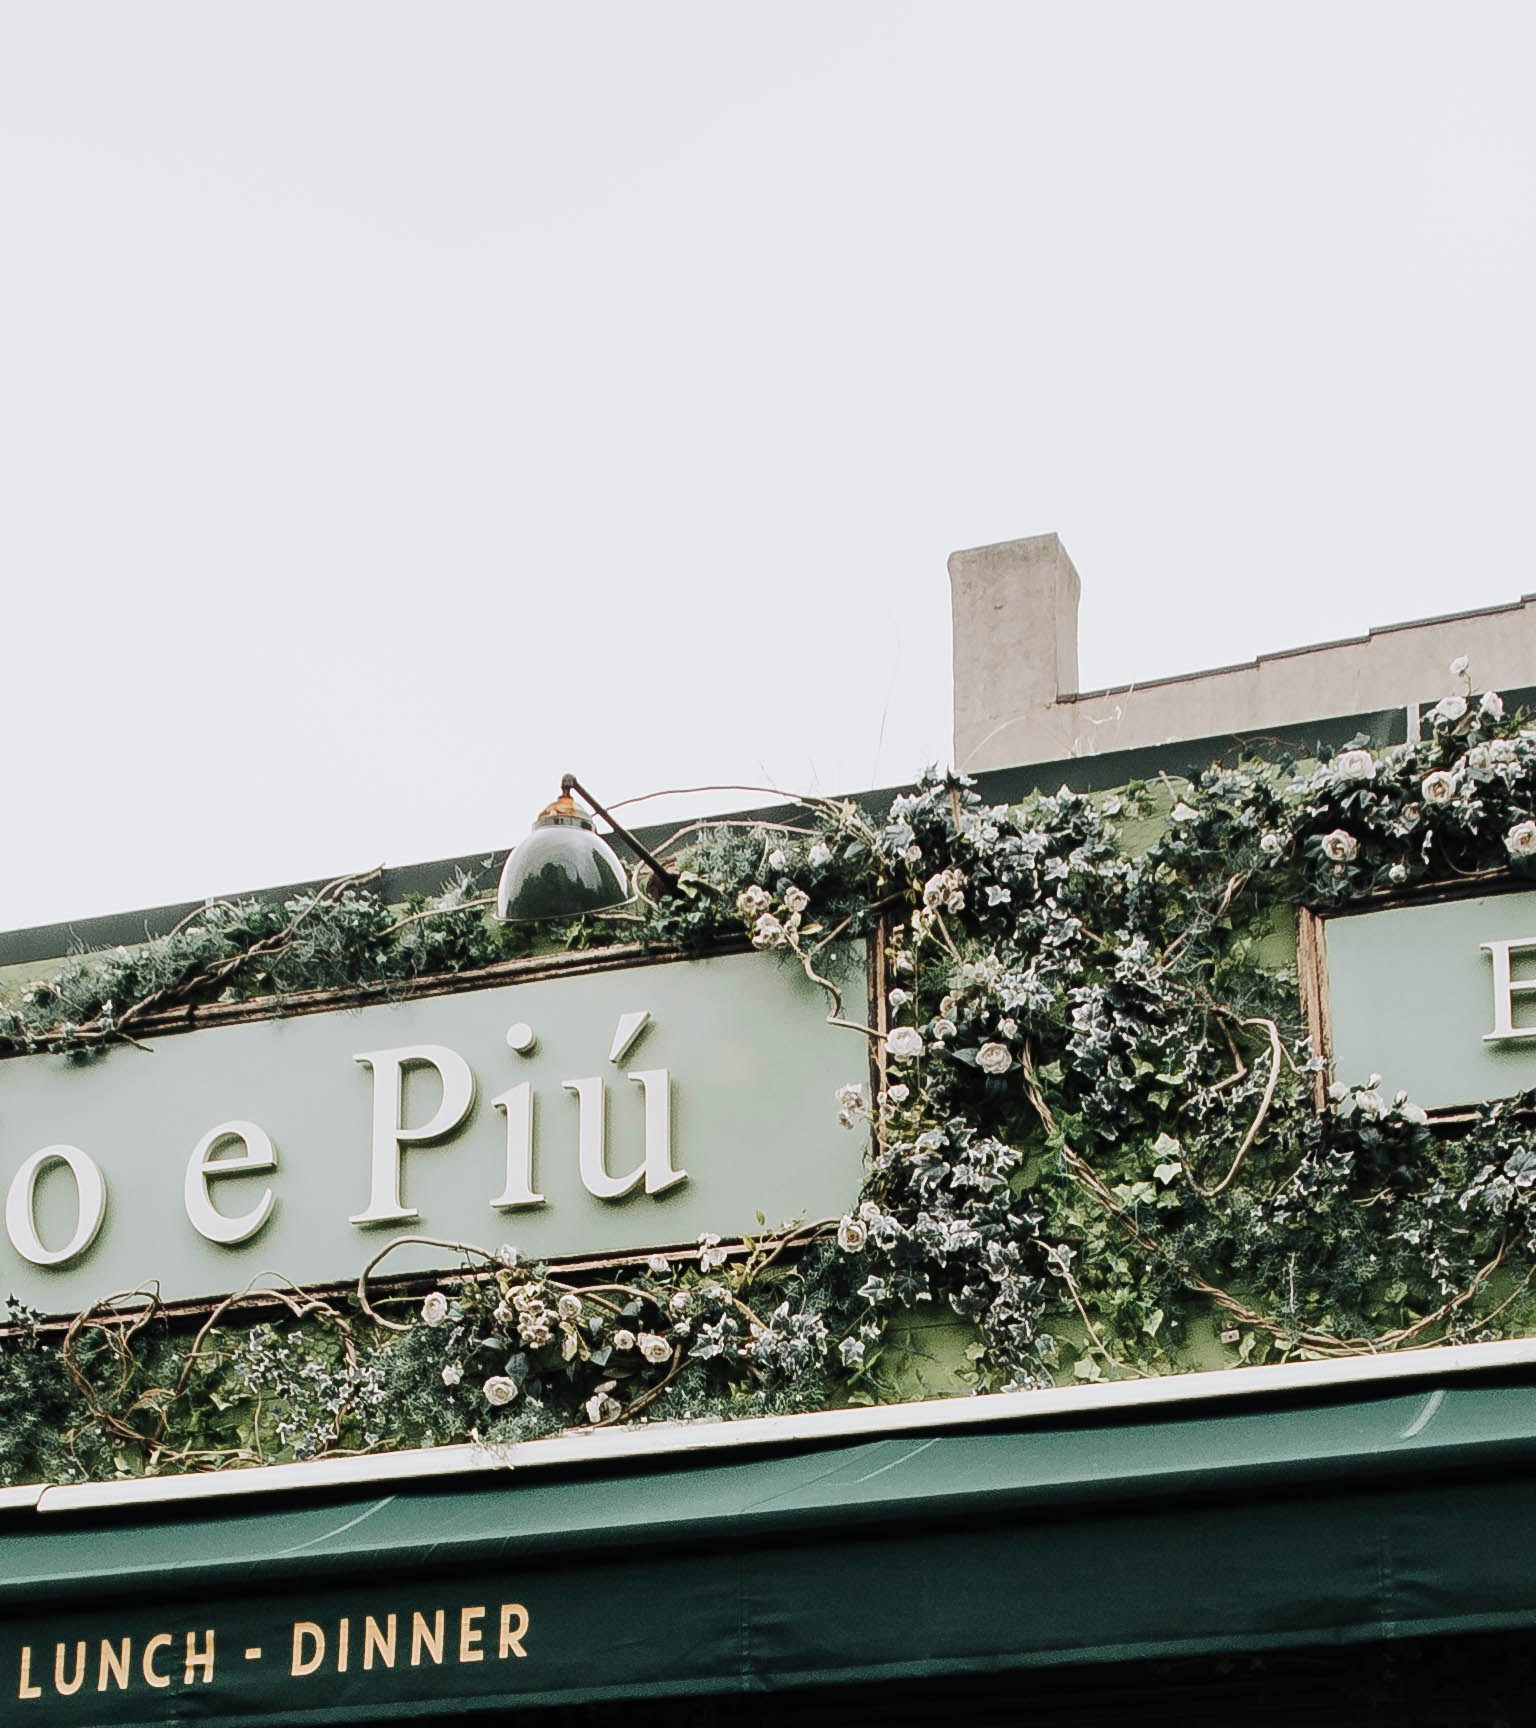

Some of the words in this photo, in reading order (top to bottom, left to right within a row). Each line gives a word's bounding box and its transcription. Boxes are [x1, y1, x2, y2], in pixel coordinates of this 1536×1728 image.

[183, 1119, 279, 1247] e
[18, 1629, 216, 1700] LUNCH
[290, 1603, 530, 1677] DINNER
